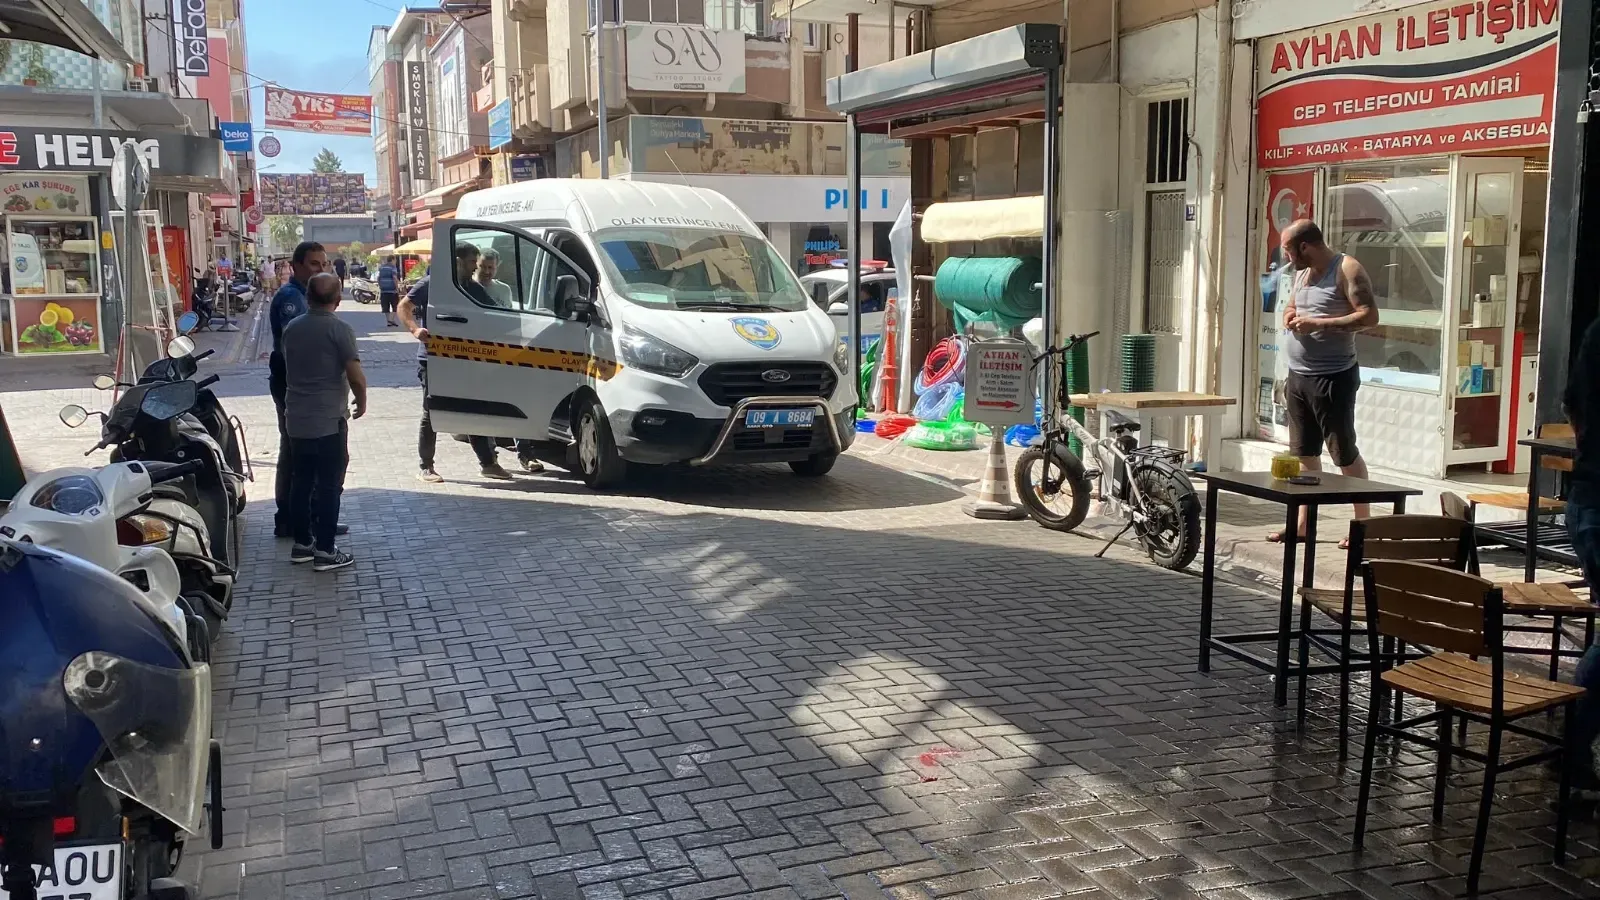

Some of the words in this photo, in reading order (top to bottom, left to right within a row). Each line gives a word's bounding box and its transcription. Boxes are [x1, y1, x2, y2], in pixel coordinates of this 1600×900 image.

[1271, 22, 1382, 74] AYHAN
[1396, 0, 1559, 51] İLETİŞİM
[652, 27, 722, 72] SAN
[412, 65, 422, 114] SMOKIN
[1293, 104, 1327, 121] CEP
[1333, 88, 1433, 115] TELEFONU
[1441, 72, 1521, 101] TAMİRİ
[297, 95, 335, 113] YKS
[224, 129, 249, 139] beko
[1264, 147, 1294, 160] KILIF
[1306, 141, 1349, 157] KAPAK
[1363, 133, 1433, 151] BATARYA
[1439, 133, 1455, 144] ve
[1462, 122, 1551, 142] AKSESUA
[416, 135, 424, 175] JEANS
[3, 181, 21, 195] EGE
[22, 180, 40, 189] KAR
[42, 180, 77, 195] ŞURUBU
[612, 217, 647, 227] OLAY
[650, 216, 680, 226] YERİ
[683, 217, 744, 232] İNCELEME
[804, 240, 840, 251] PHILIPS
[425, 343, 440, 351] LAY
[442, 343, 459, 352] YERİ
[460, 344, 497, 357] İNCELEME
[1259, 343, 1280, 351] NOKIA
[561, 357, 581, 367] OLAY
[983, 351, 1019, 360] AYHAN
[980, 361, 1023, 372] İLETİŞİM
[753, 411, 766, 423] 09
[773, 411, 779, 423] A
[787, 411, 812, 423] 8684
[35, 849, 115, 888] AOU
